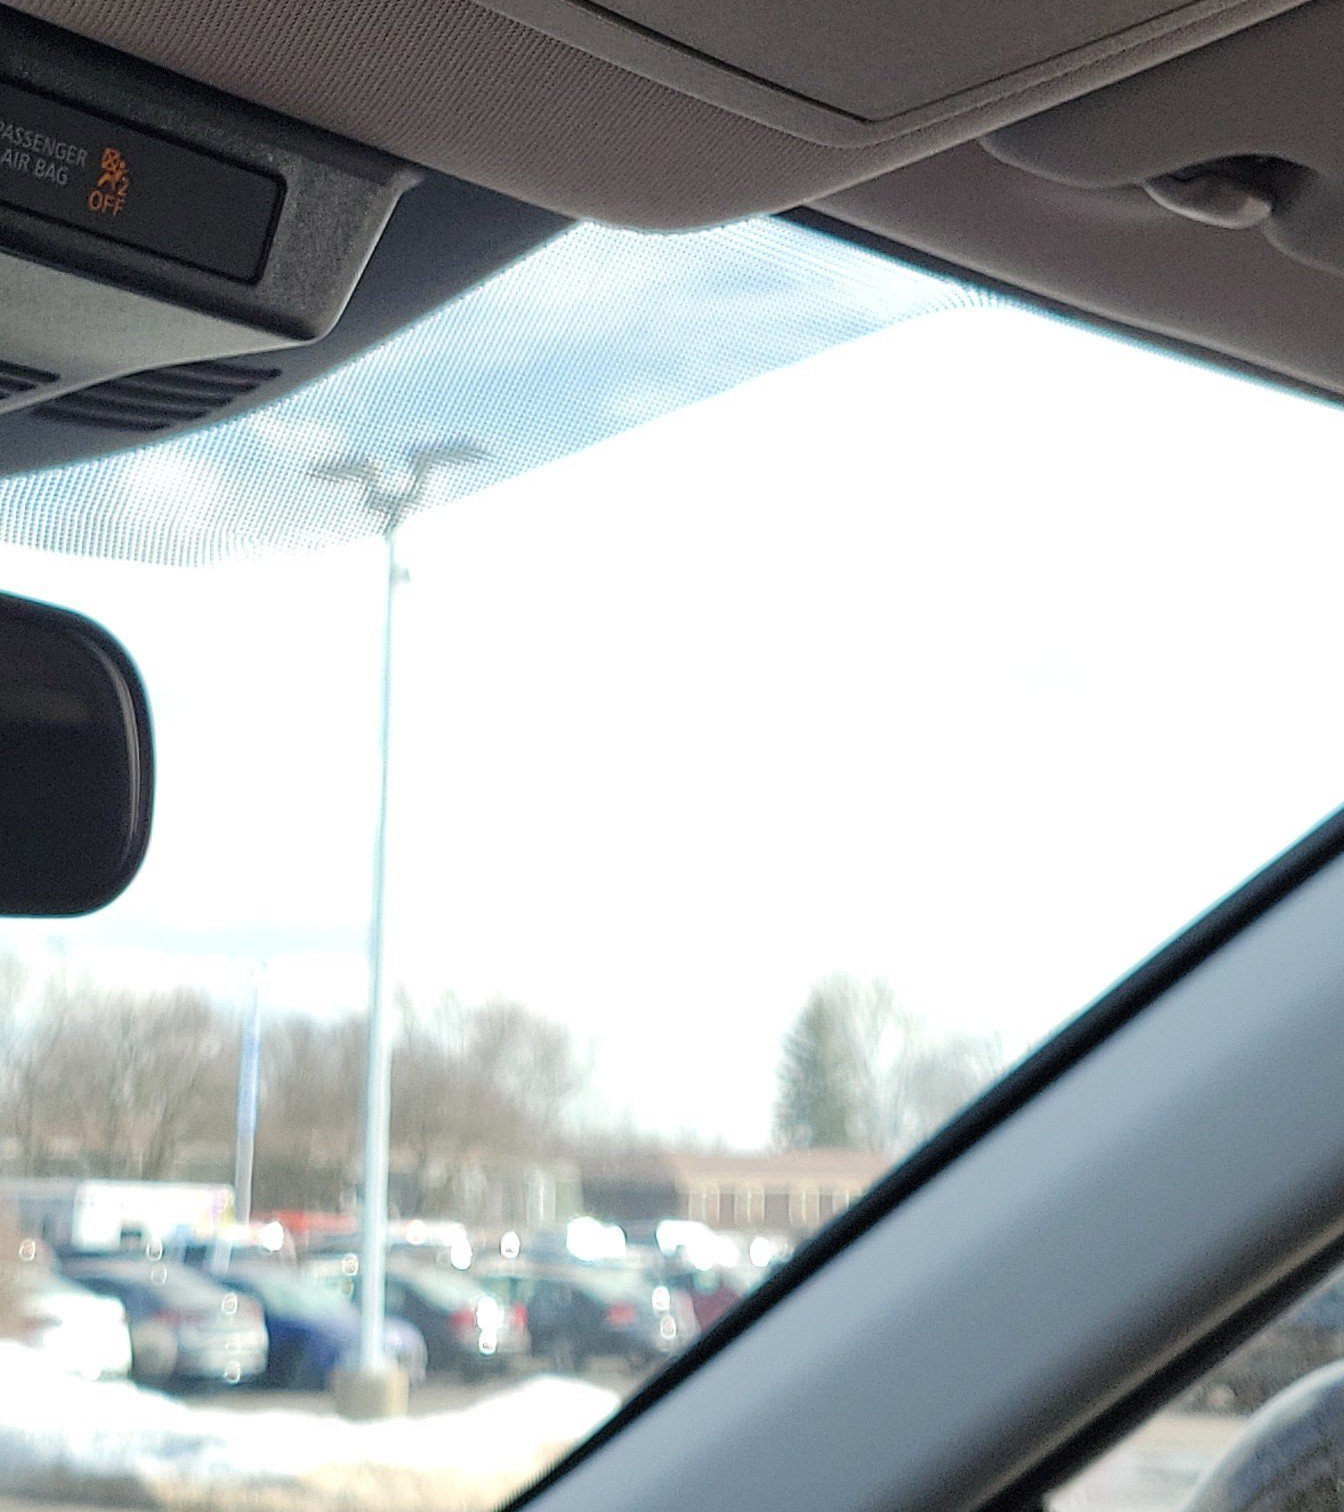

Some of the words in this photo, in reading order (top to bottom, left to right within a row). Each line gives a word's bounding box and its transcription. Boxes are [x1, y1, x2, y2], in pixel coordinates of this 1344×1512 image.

[0, 148, 31, 172] AIR
[34, 157, 70, 186] BAG
[87, 188, 126, 217] OFF
